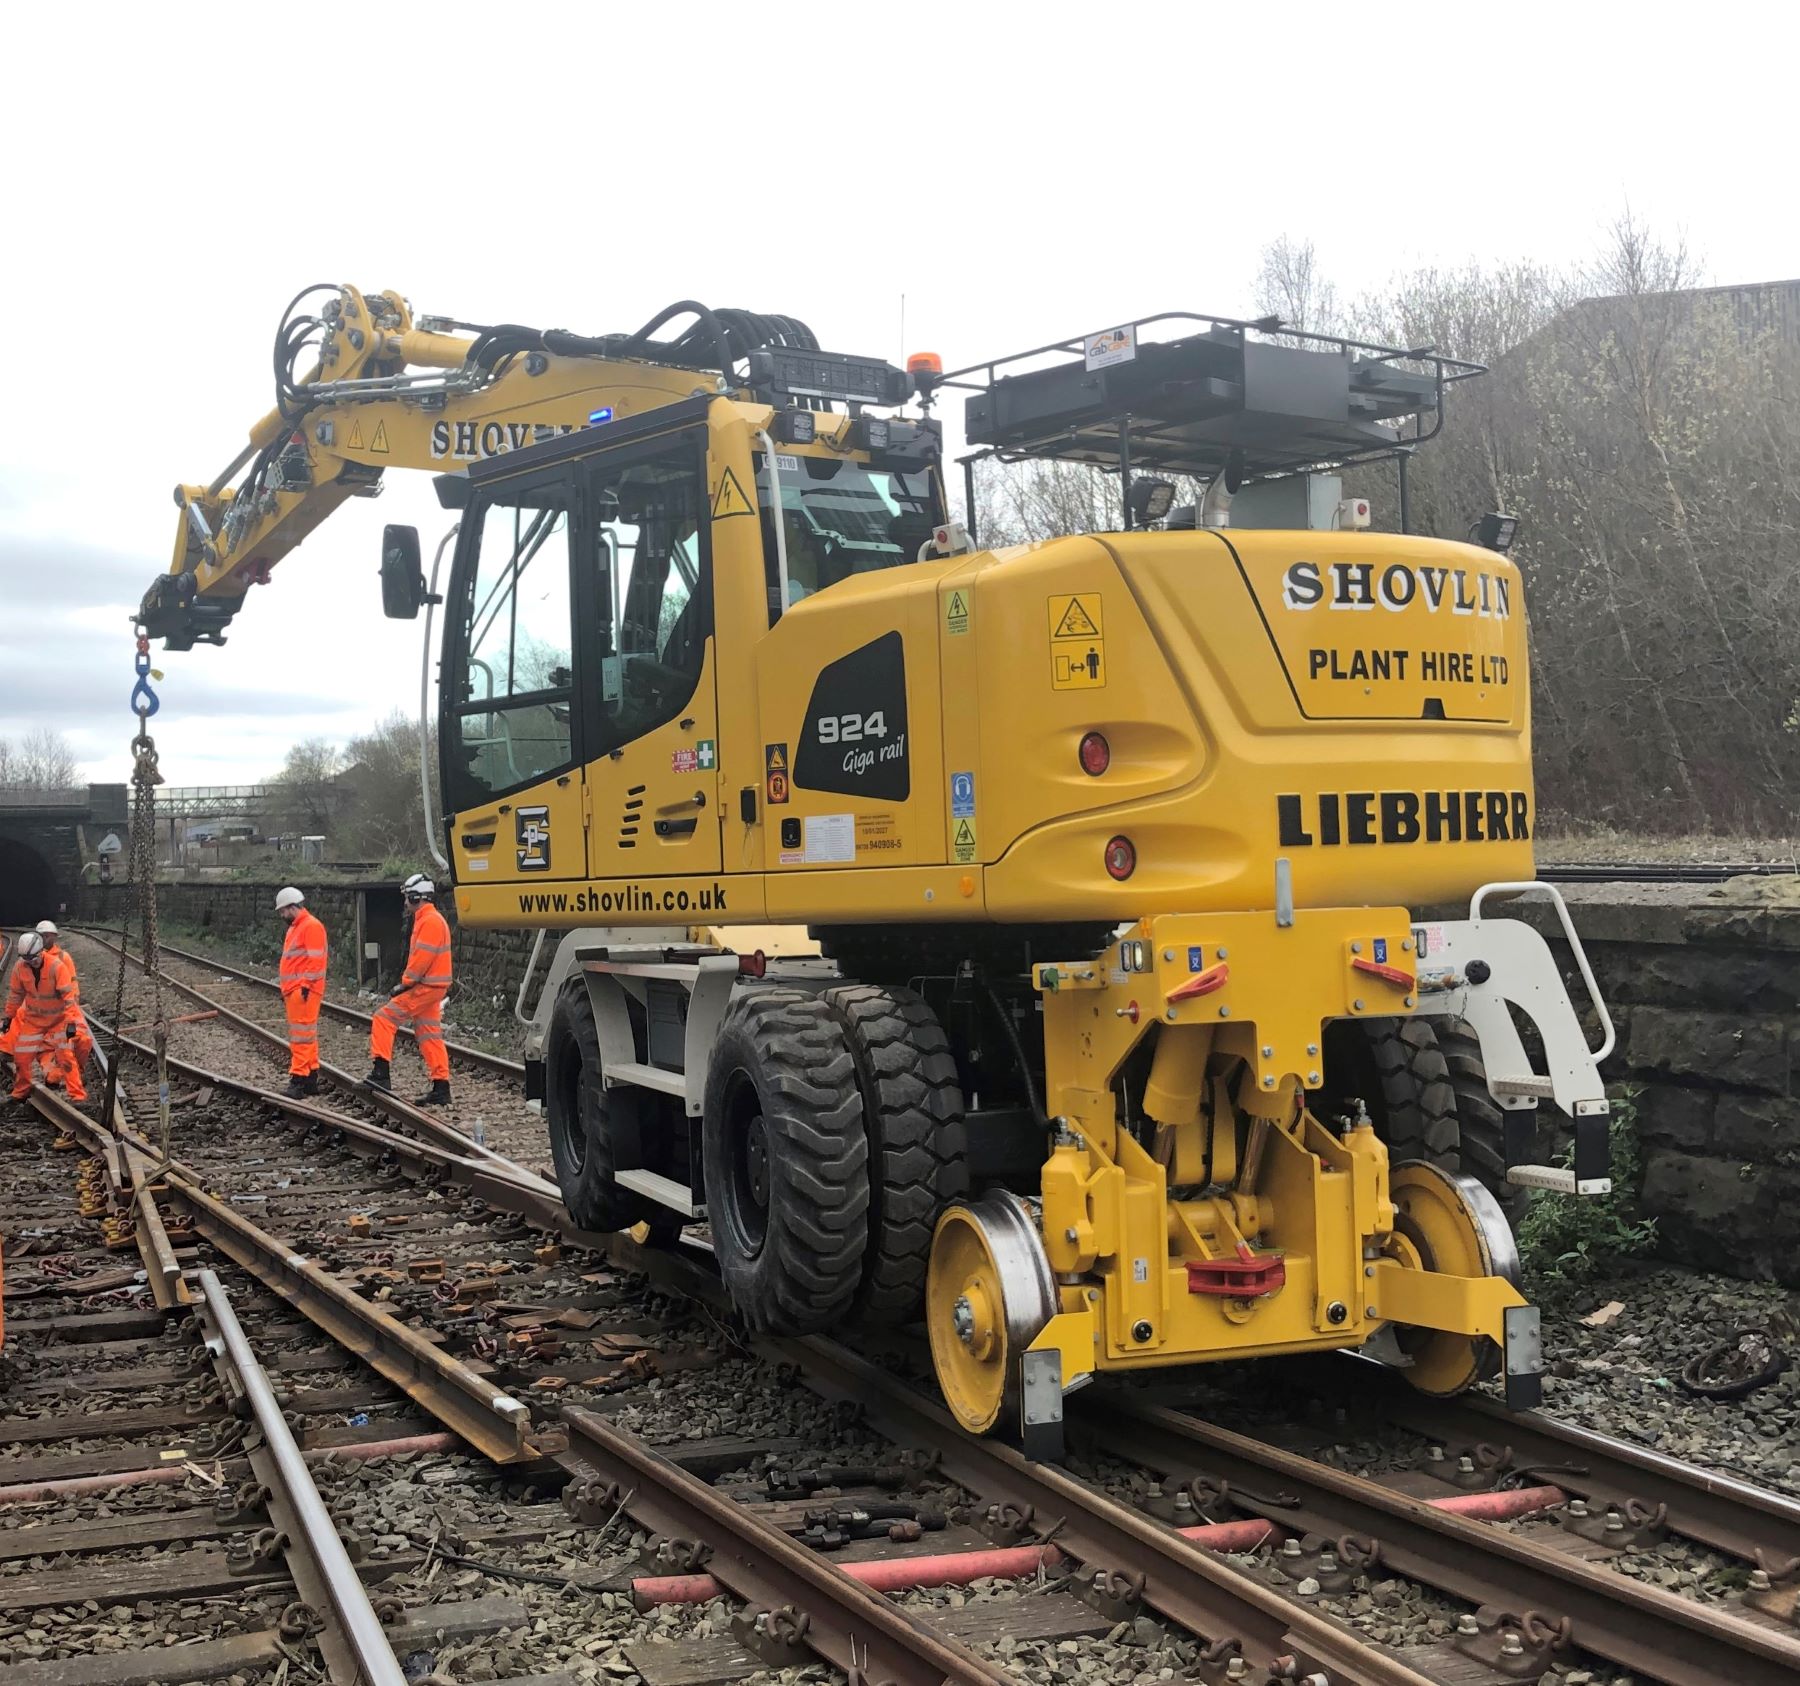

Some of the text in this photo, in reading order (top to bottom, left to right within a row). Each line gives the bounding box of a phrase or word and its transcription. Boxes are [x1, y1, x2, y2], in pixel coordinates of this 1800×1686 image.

[430, 420, 592, 461] SHOV
[1282, 561, 1511, 621] SHOVLIN
[1309, 649, 1508, 685] PLANT HIRE LTD
[818, 710, 888, 744] 924
[676, 751, 693, 761] FIRE
[842, 733, 904, 775] Giga rail
[1276, 790, 1530, 847] LIEBHERR
[518, 883, 727, 913] www.shovlin.co.uk
